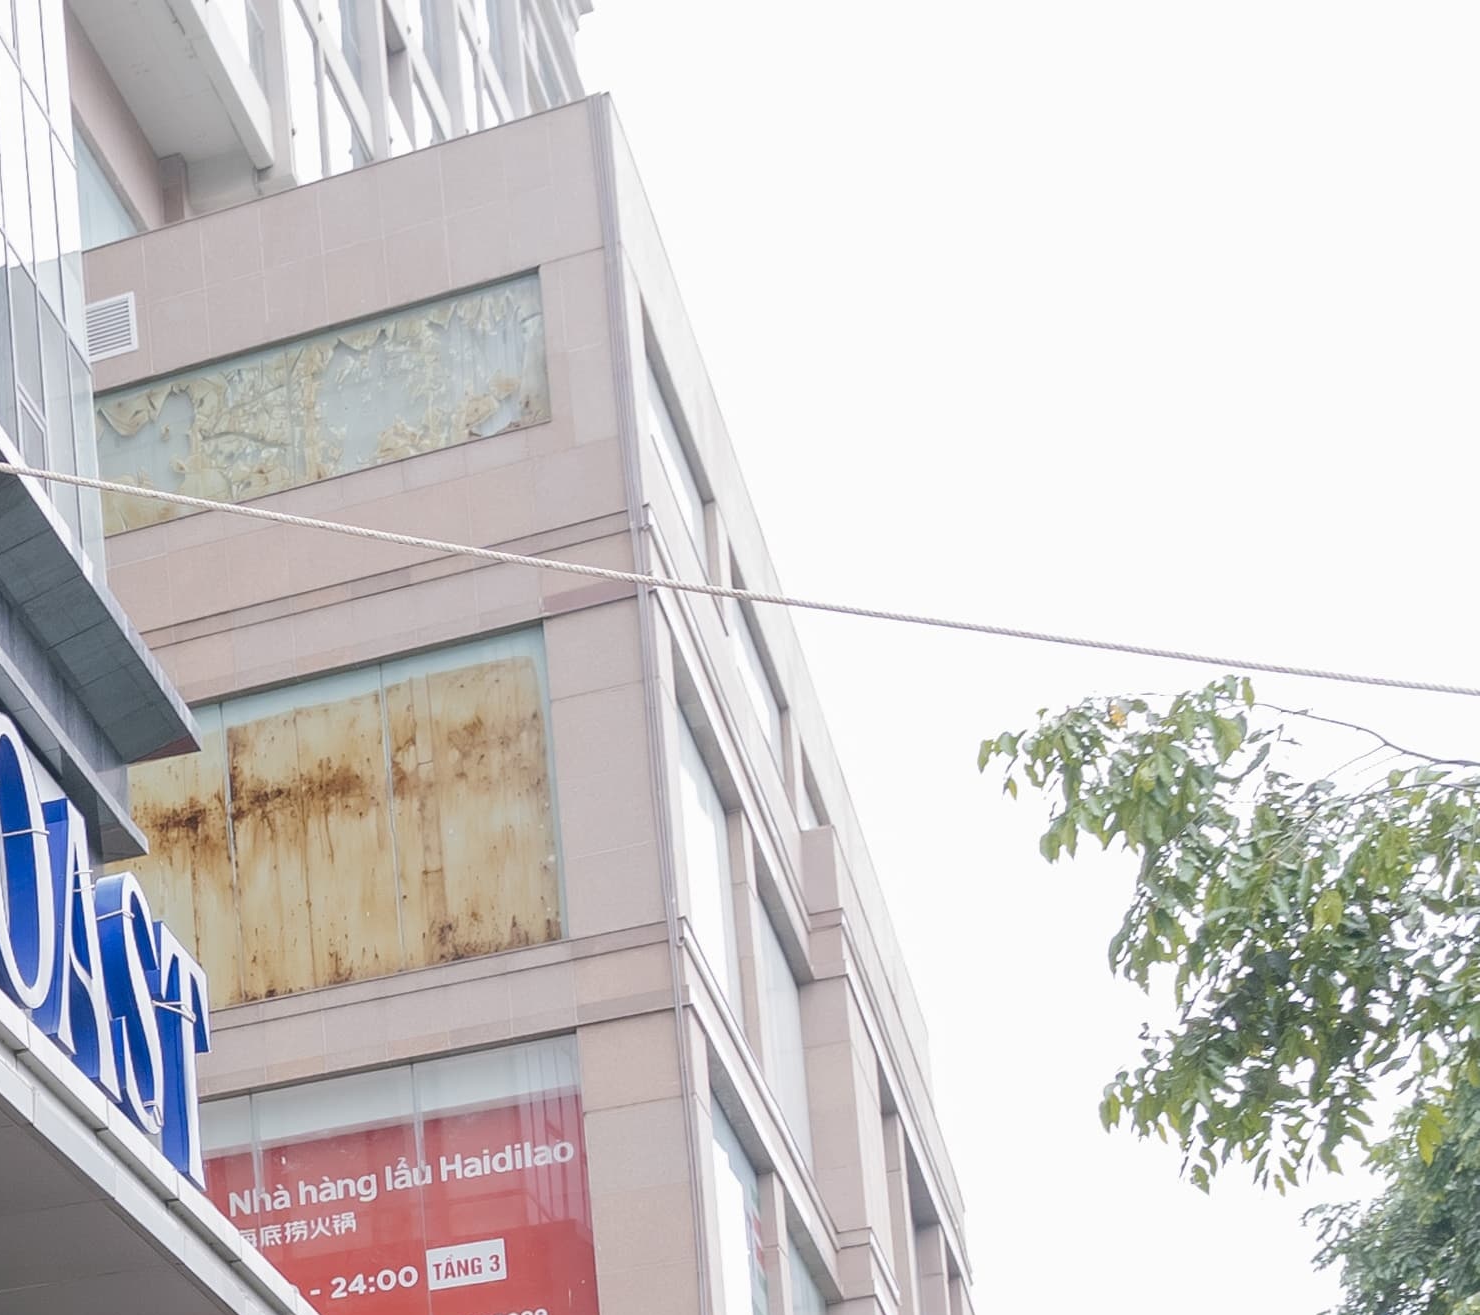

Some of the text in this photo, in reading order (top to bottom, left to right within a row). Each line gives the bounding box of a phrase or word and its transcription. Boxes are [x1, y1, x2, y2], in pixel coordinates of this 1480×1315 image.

[229, 1140, 575, 1217] Nhà hàng lẩu Haidilao
[330, 1265, 419, 1299] 24:00
[432, 1254, 483, 1281] TẦNG
[488, 1254, 502, 1273] 3
